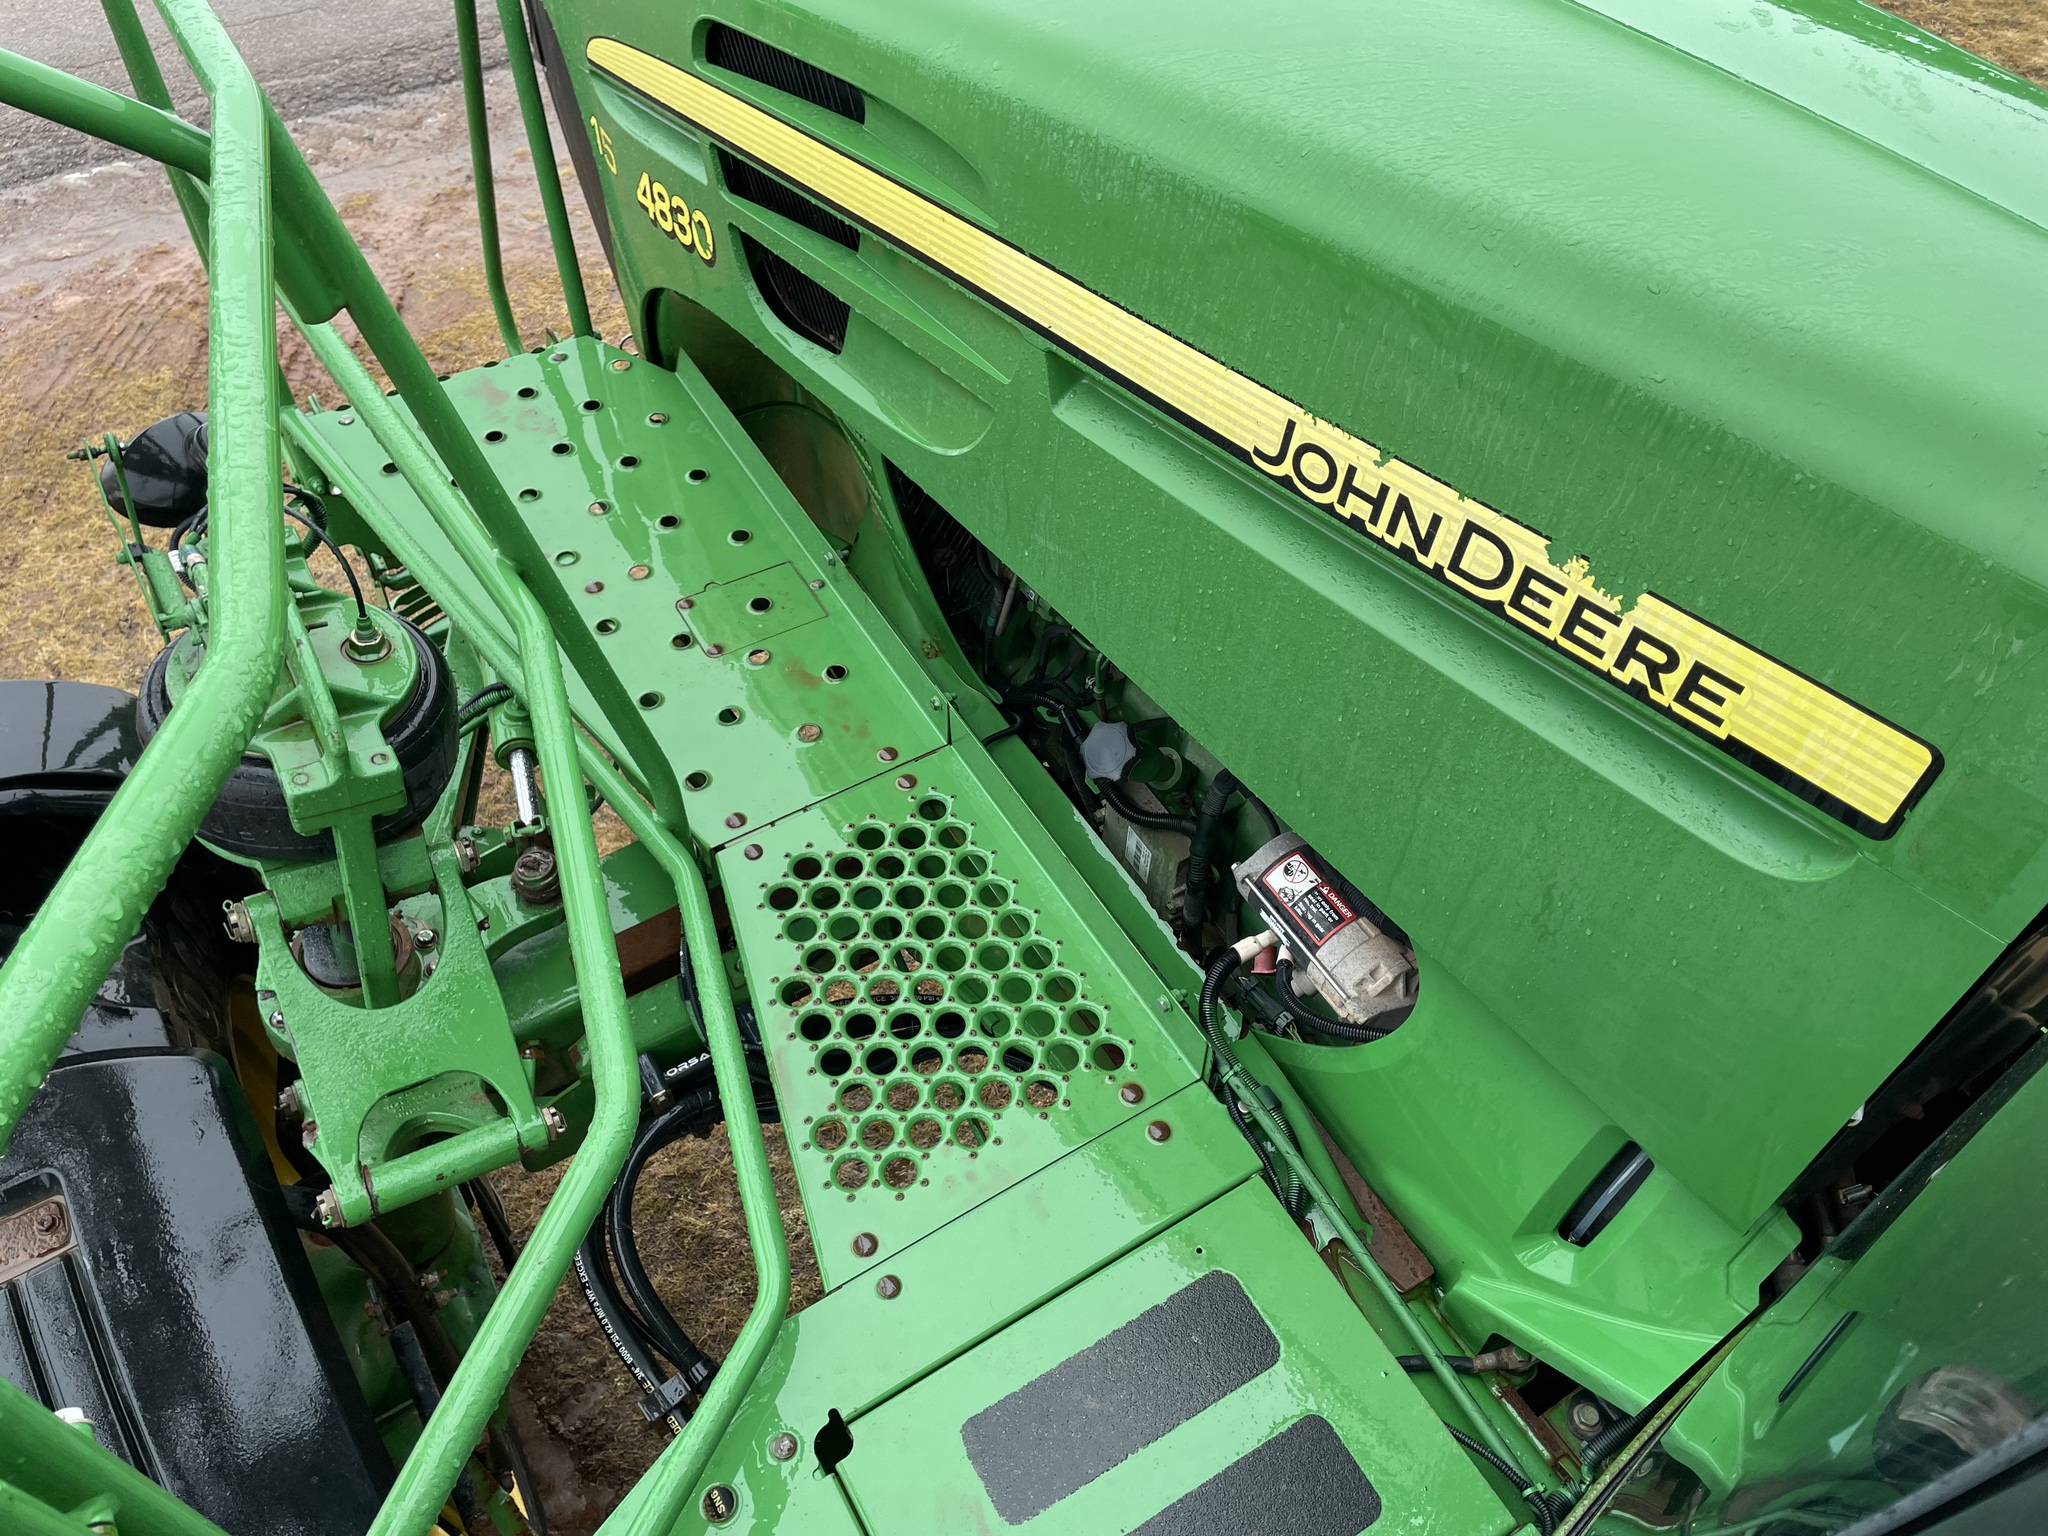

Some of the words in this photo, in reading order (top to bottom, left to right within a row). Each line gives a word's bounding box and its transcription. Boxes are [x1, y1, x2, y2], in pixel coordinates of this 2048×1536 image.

[590, 115, 617, 175] 15
[636, 171, 717, 268] 4830
[1252, 418, 1443, 558] JOHN
[1446, 519, 1746, 729] DEERE
[1328, 892, 1352, 919] DANGER
[664, 1052, 711, 1077] ORSA
[585, 1288, 597, 1303] WP
[592, 1301, 606, 1319] MPa
[601, 1318, 614, 1334] 42.0
[610, 1332, 623, 1348] PSI
[618, 1346, 634, 1364] 6000
[642, 1380, 655, 1394] CE
